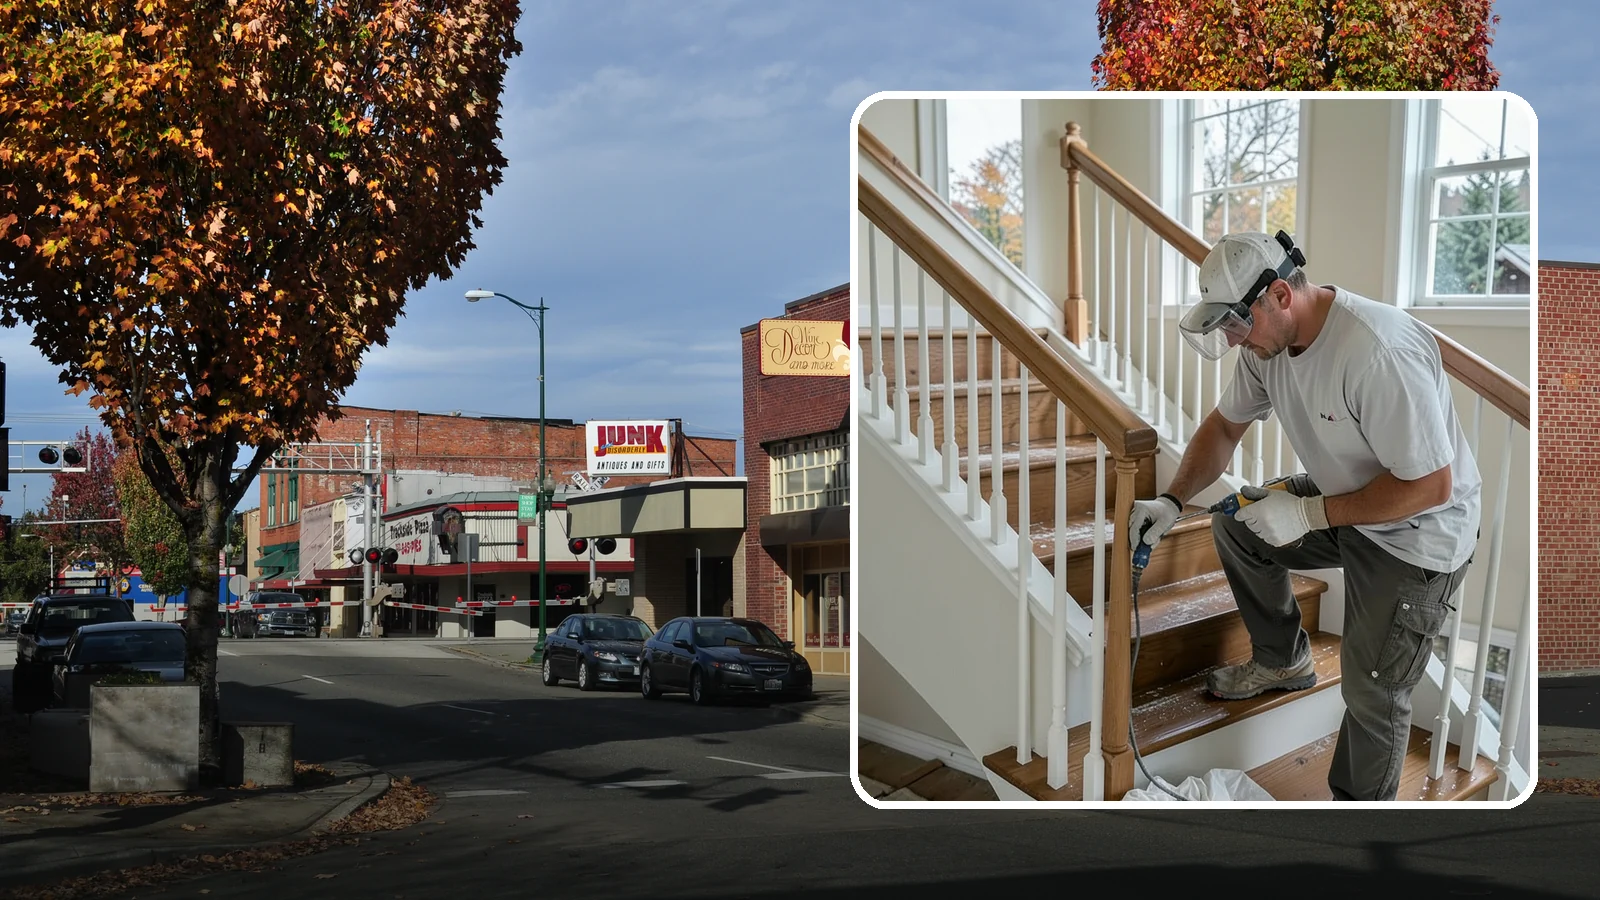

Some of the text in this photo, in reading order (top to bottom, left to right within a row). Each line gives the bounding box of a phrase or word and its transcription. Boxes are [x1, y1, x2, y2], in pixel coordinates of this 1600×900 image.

[765, 327, 830, 365] Decor
[595, 425, 665, 457] JUNK
[597, 461, 665, 470] ANTIQUES AND GIFTS
[414, 519, 429, 535] Pizza
